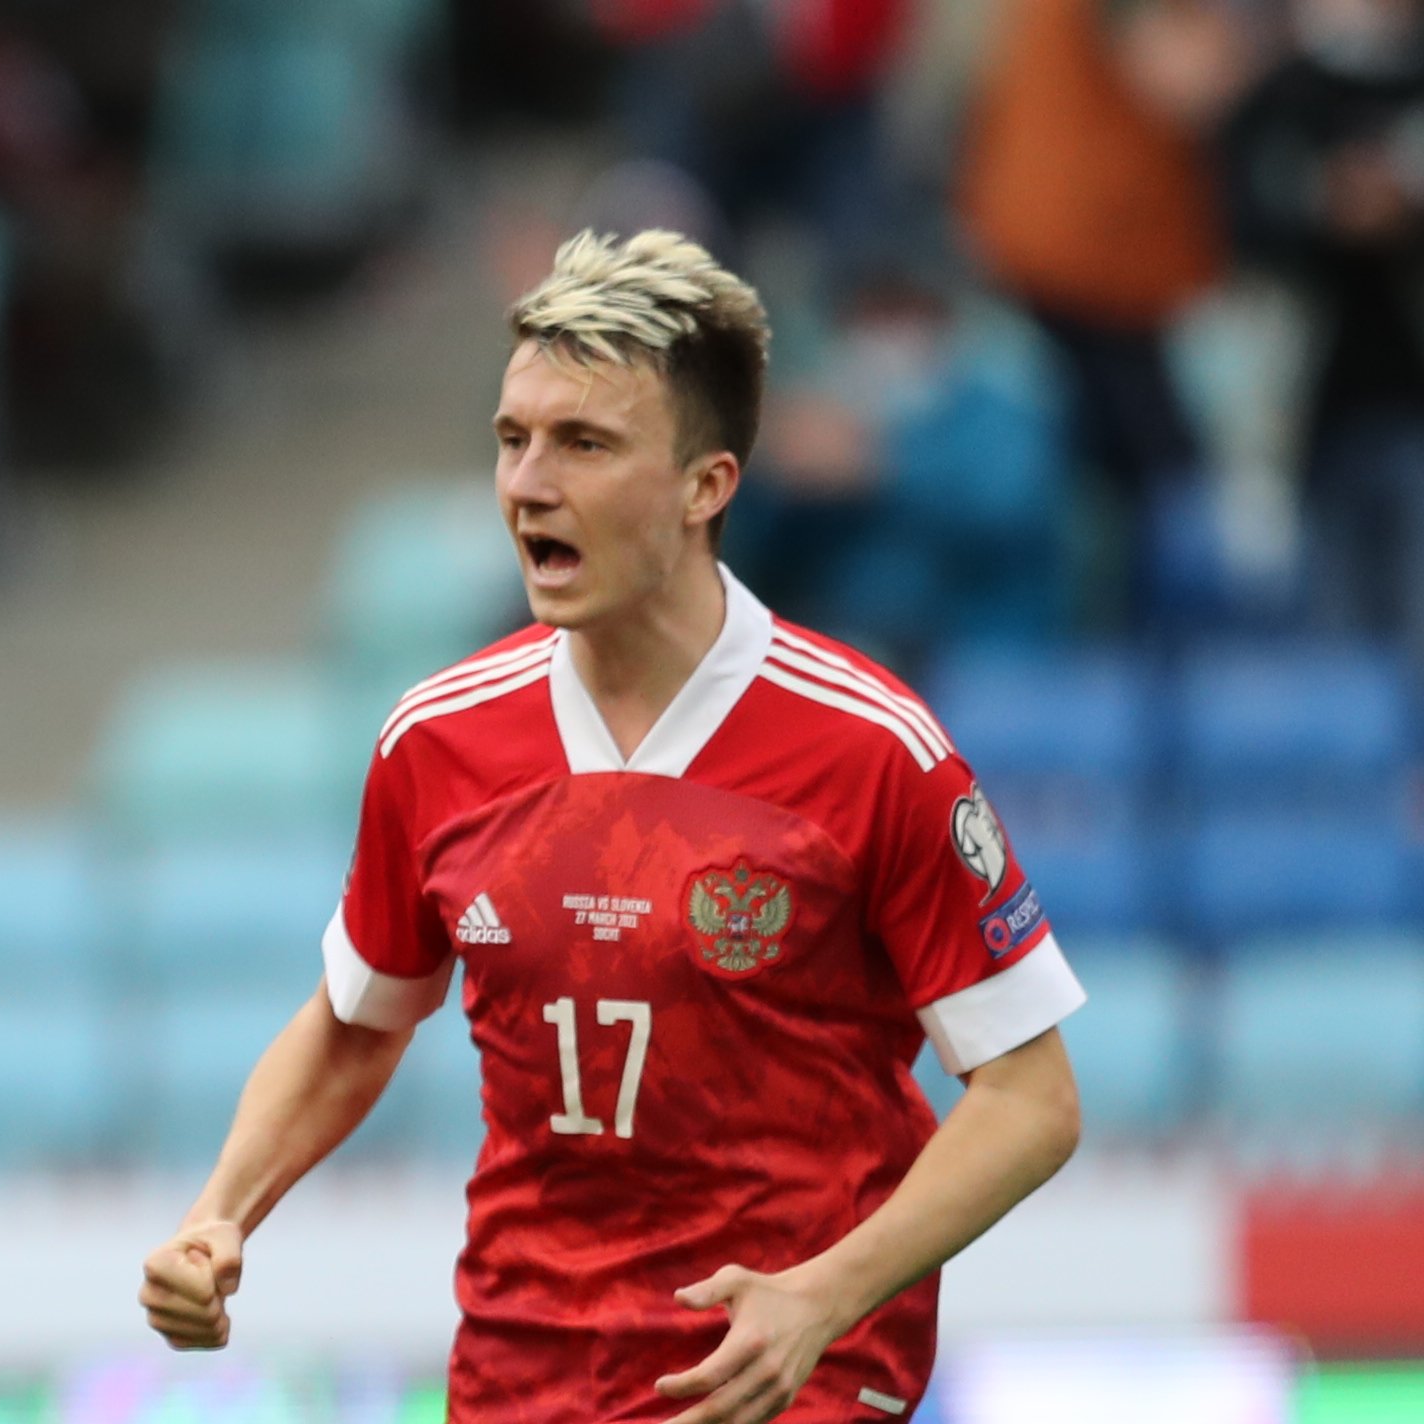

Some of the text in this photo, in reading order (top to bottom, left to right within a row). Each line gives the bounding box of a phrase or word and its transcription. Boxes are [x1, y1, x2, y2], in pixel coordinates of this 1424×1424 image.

[575, 911, 586, 924] 27
[456, 926, 511, 943] adidas
[543, 997, 651, 1139] 17
